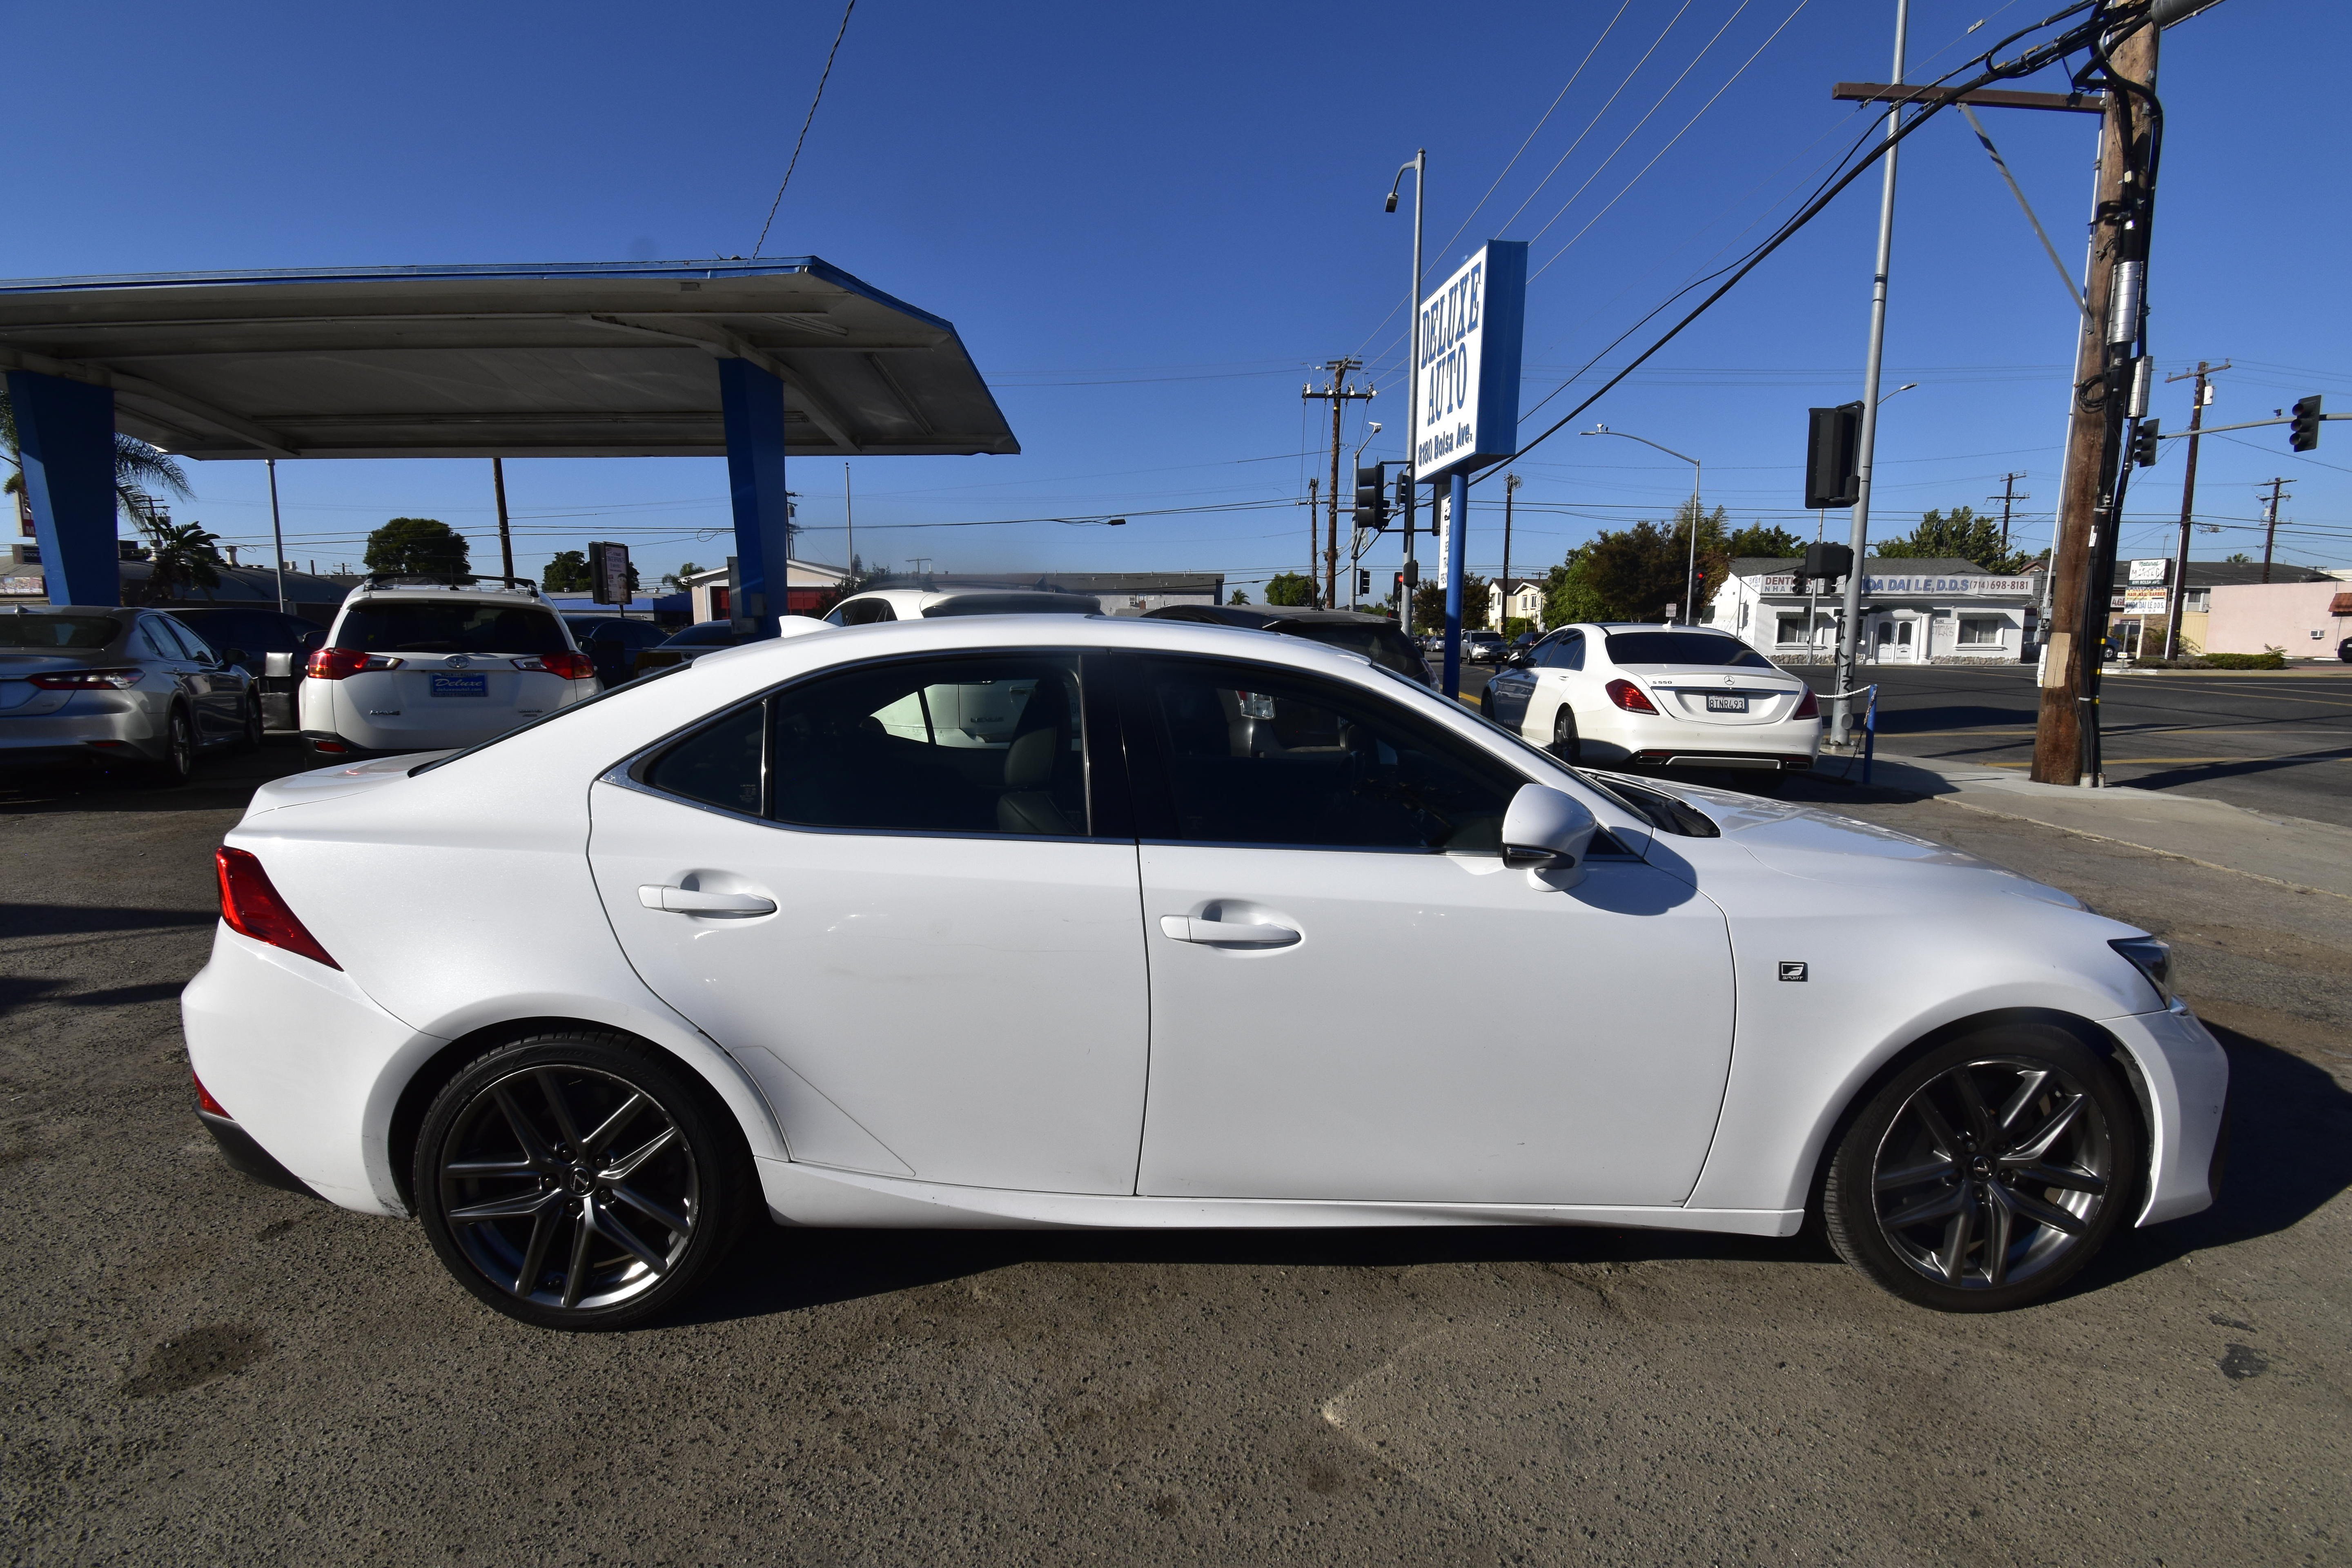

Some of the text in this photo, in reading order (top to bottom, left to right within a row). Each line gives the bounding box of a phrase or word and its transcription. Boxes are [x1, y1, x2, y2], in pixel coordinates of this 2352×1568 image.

[1421, 261, 1481, 370] DELUXE
[1428, 342, 1467, 427] AUTO
[1418, 422, 1473, 467] 8180 Bolsa Ave.
[1887, 579, 1911, 591] DAI
[1914, 579, 1934, 593] LE,
[1969, 581, 2028, 590] (714) 698-8181
[1709, 699, 1743, 709] 8TNR493
